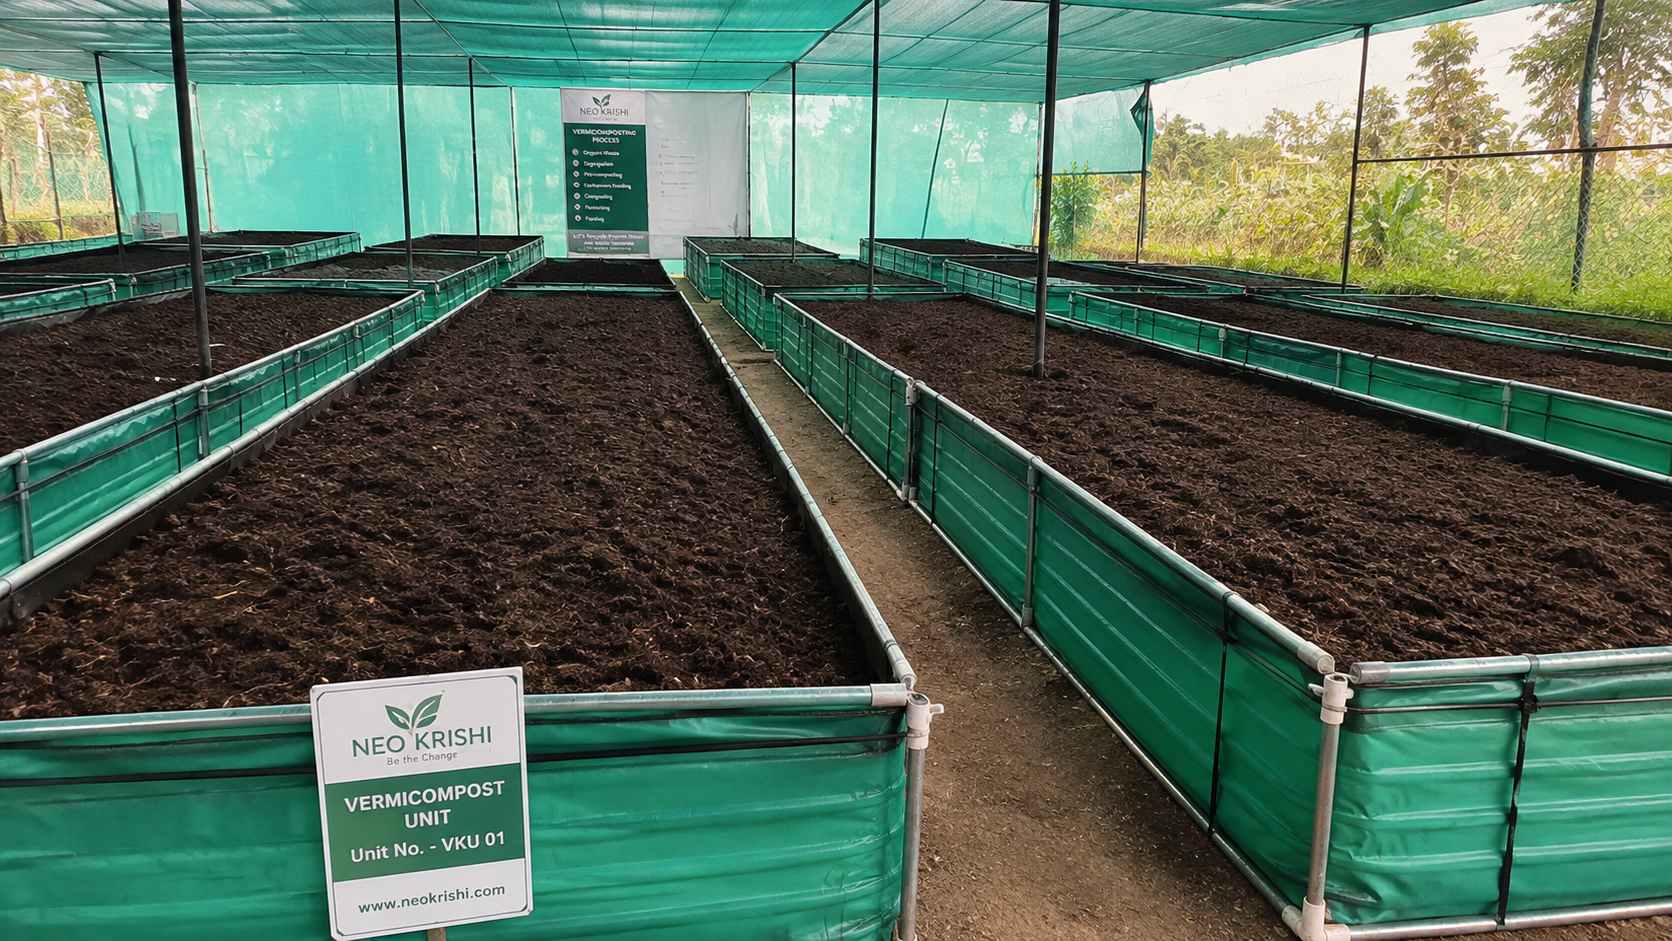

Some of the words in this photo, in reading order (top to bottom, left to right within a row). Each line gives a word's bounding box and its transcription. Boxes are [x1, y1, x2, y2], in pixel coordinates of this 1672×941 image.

[579, 107, 599, 116] NEO
[600, 107, 629, 117] KRISHI
[352, 735, 406, 758] NEO
[415, 726, 492, 750] KRISHI
[387, 756, 400, 766] Be
[403, 754, 418, 764] the
[422, 750, 458, 762] Change
[344, 780, 505, 812] VERMICOMPOST
[404, 808, 451, 829] UNIT
[351, 844, 390, 862] Unit
[394, 842, 424, 858] No.
[441, 834, 480, 852] VKU
[485, 831, 505, 847] 01
[358, 885, 505, 914] www.neokrishi.com
